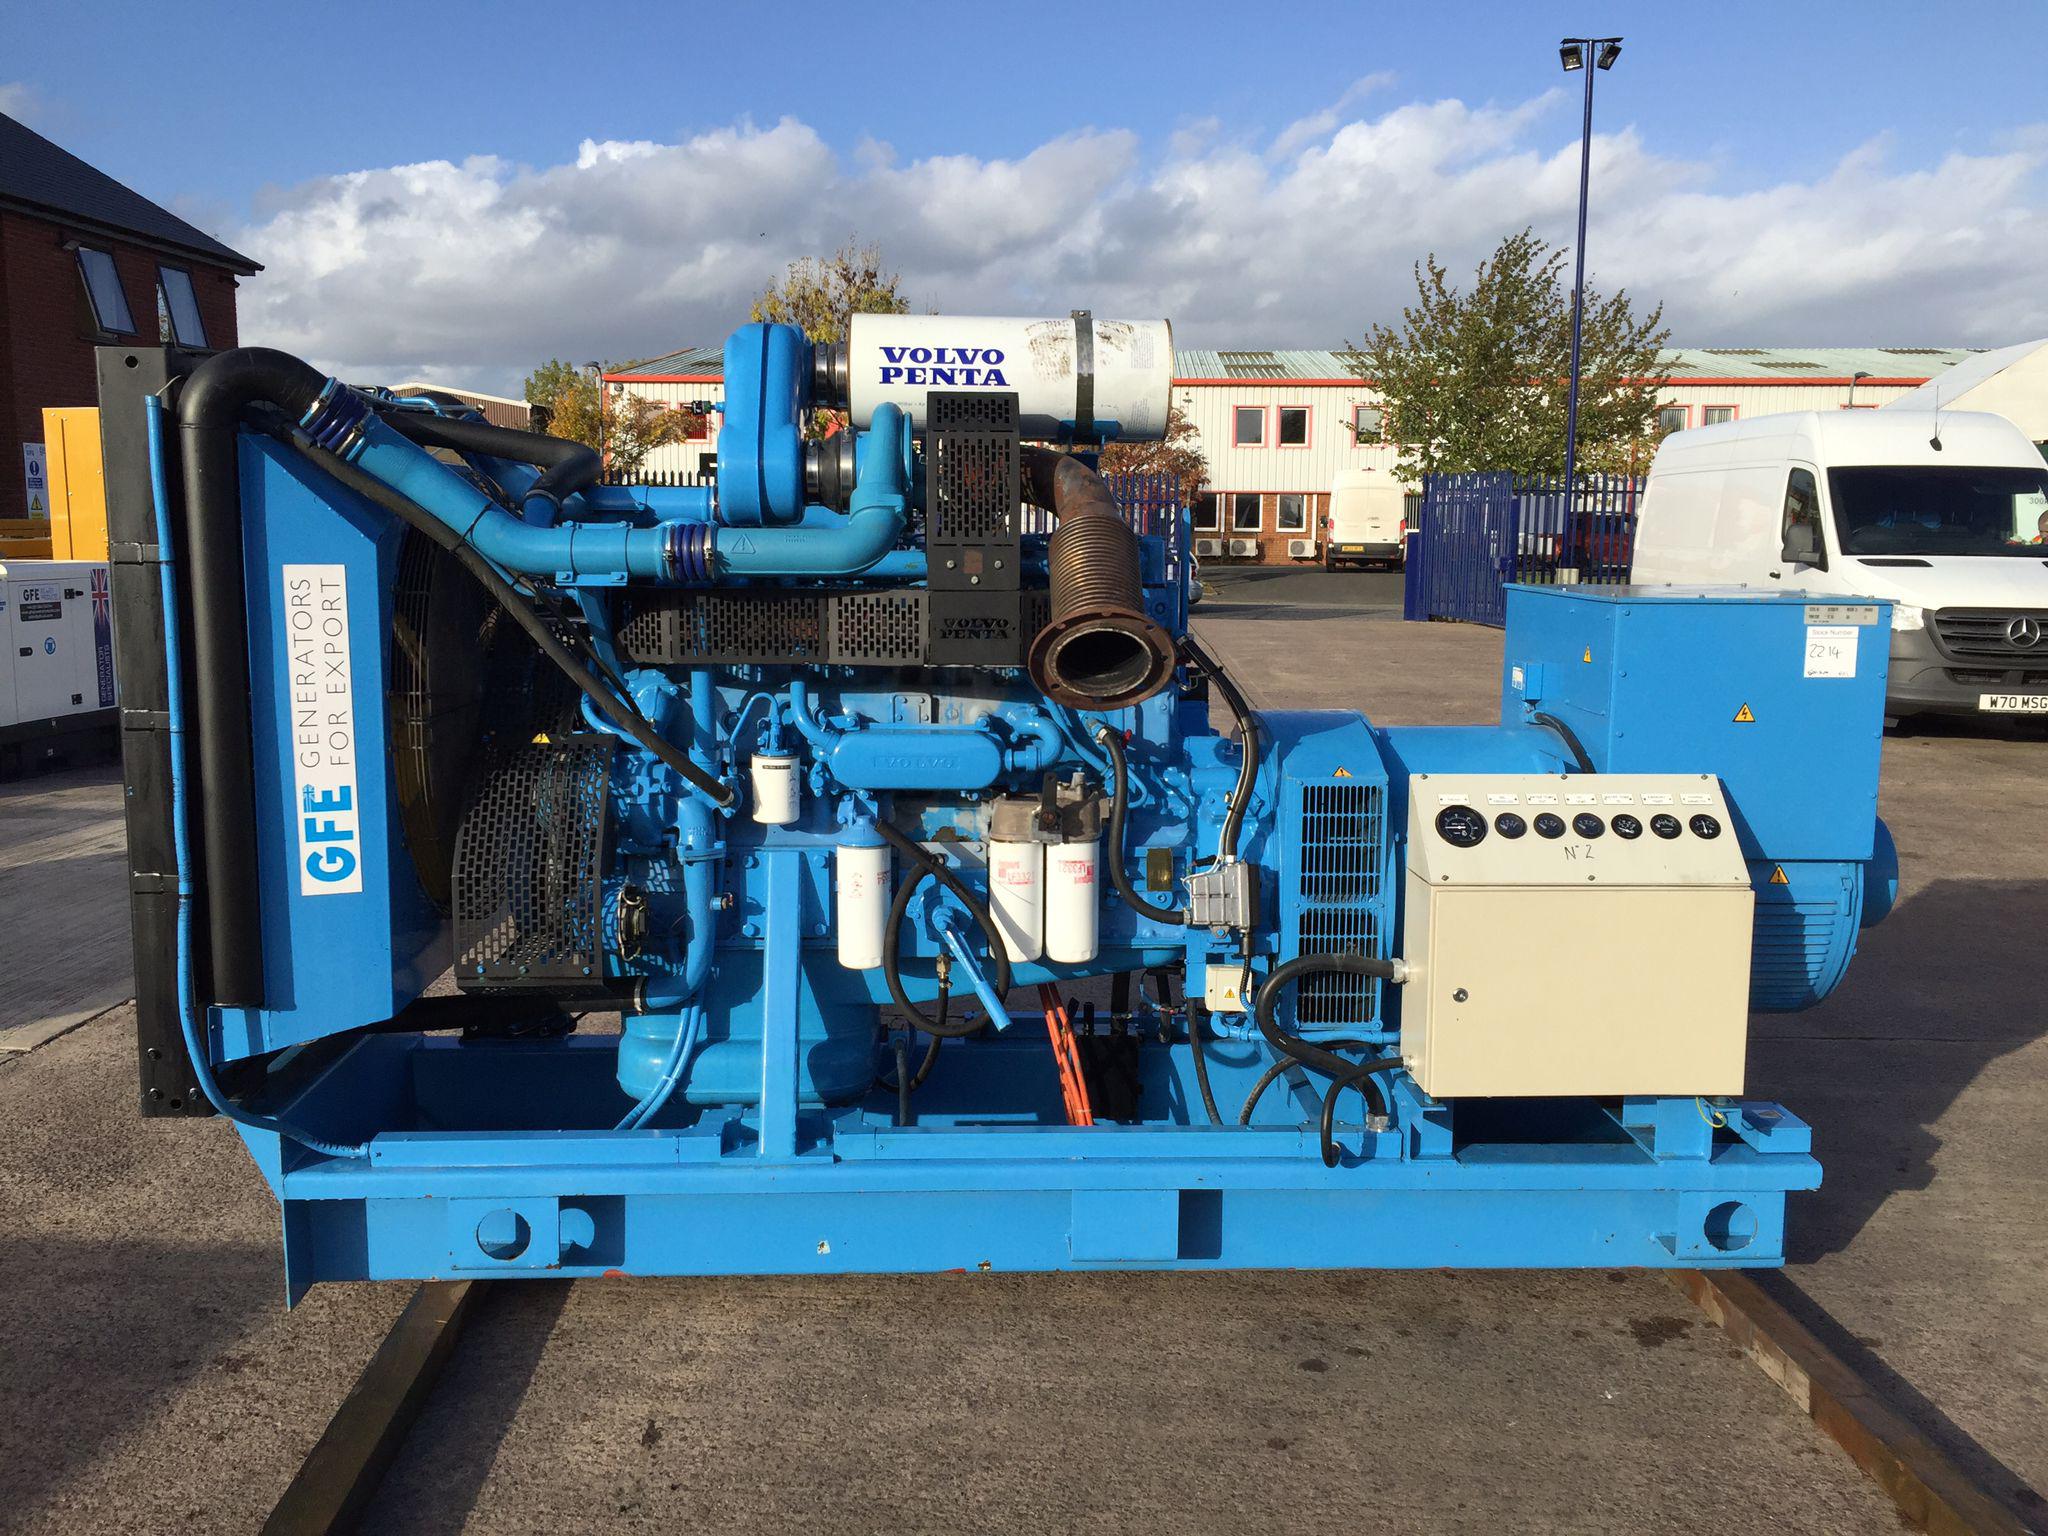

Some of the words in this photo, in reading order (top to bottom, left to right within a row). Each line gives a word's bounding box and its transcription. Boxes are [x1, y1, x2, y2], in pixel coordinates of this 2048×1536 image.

[879, 346, 1005, 365] VOLVO
[879, 367, 1011, 386] PENTA
[23, 589, 40, 601] GFE
[944, 618, 1009, 628] VOLVO
[320, 577, 347, 695] EXPORT
[940, 629, 1009, 639] PENTA
[1808, 643, 1841, 659] 2214
[98, 646, 107, 702] GENERATOR
[104, 644, 113, 701] SPECIALISTS
[290, 578, 321, 768] GENERATORS
[1990, 696, 2018, 709] W70
[2021, 696, 2048, 709] MSG
[327, 709, 351, 766] FOR
[303, 784, 357, 883] GFE
